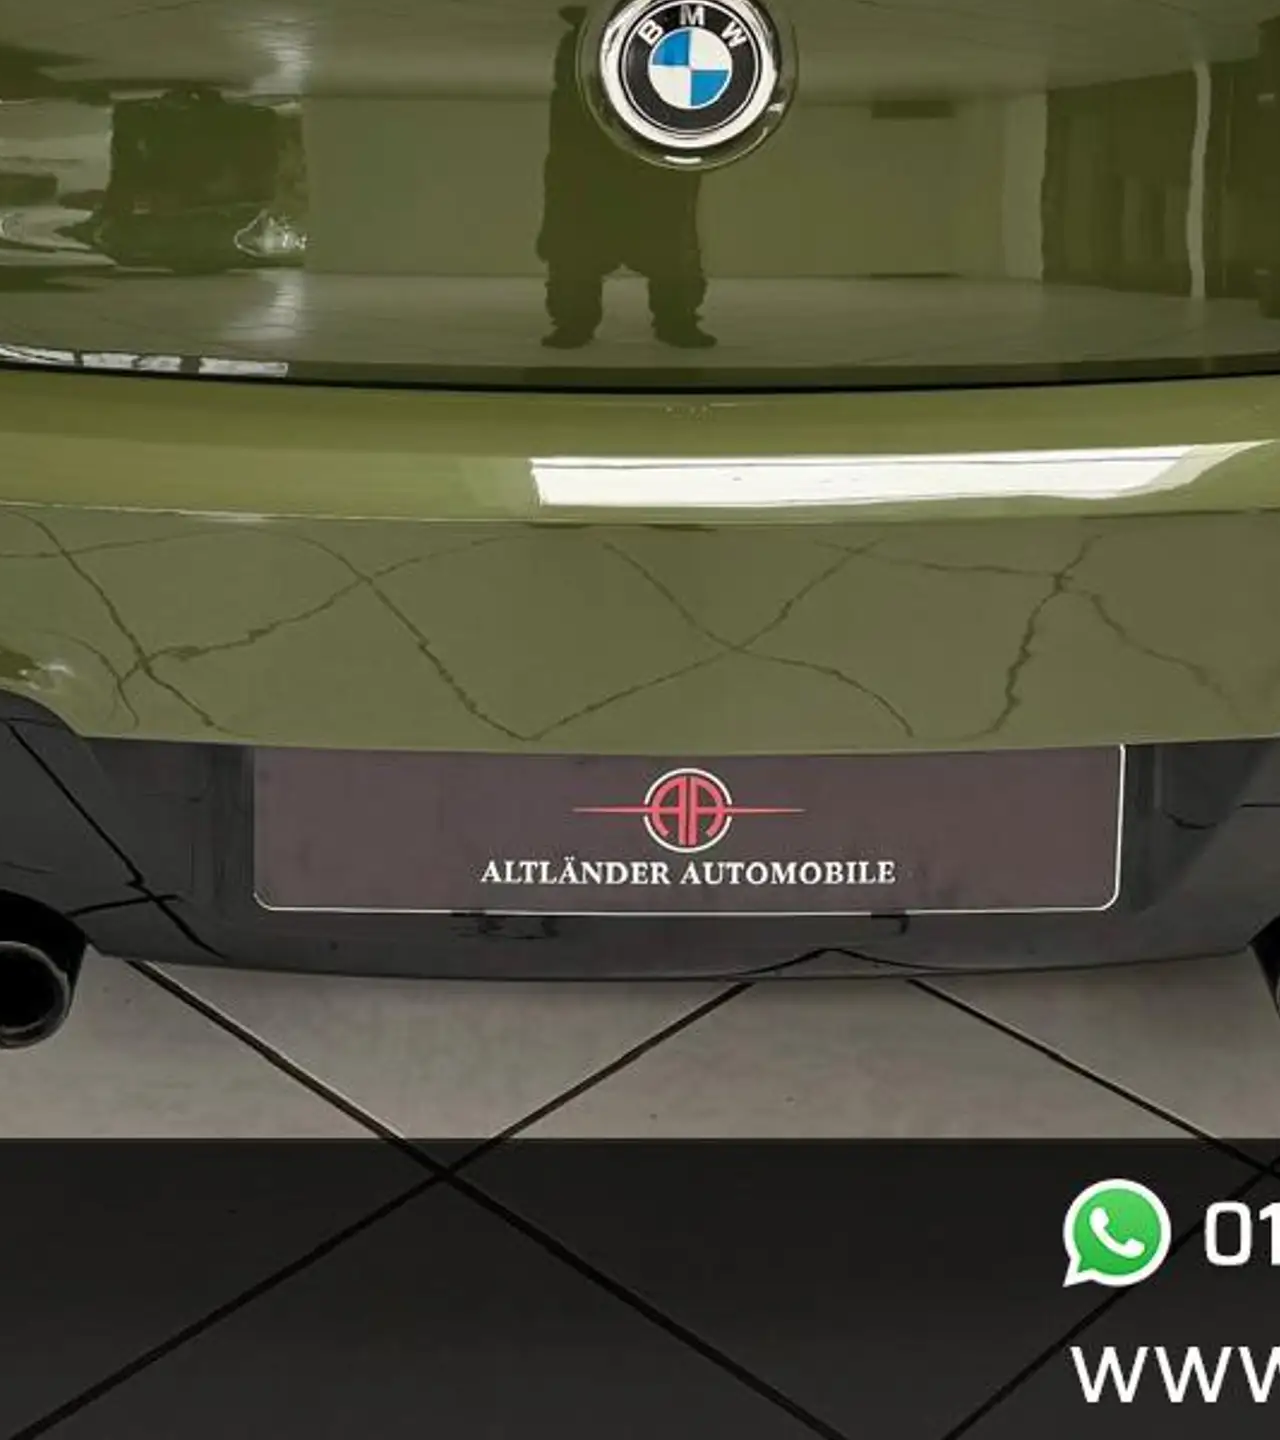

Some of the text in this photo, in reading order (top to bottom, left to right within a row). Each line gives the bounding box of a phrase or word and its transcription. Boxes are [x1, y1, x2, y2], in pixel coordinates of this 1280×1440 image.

[637, 3, 747, 48] BMW
[481, 856, 896, 885] ALTLÄNDER AUTOMOBILE
